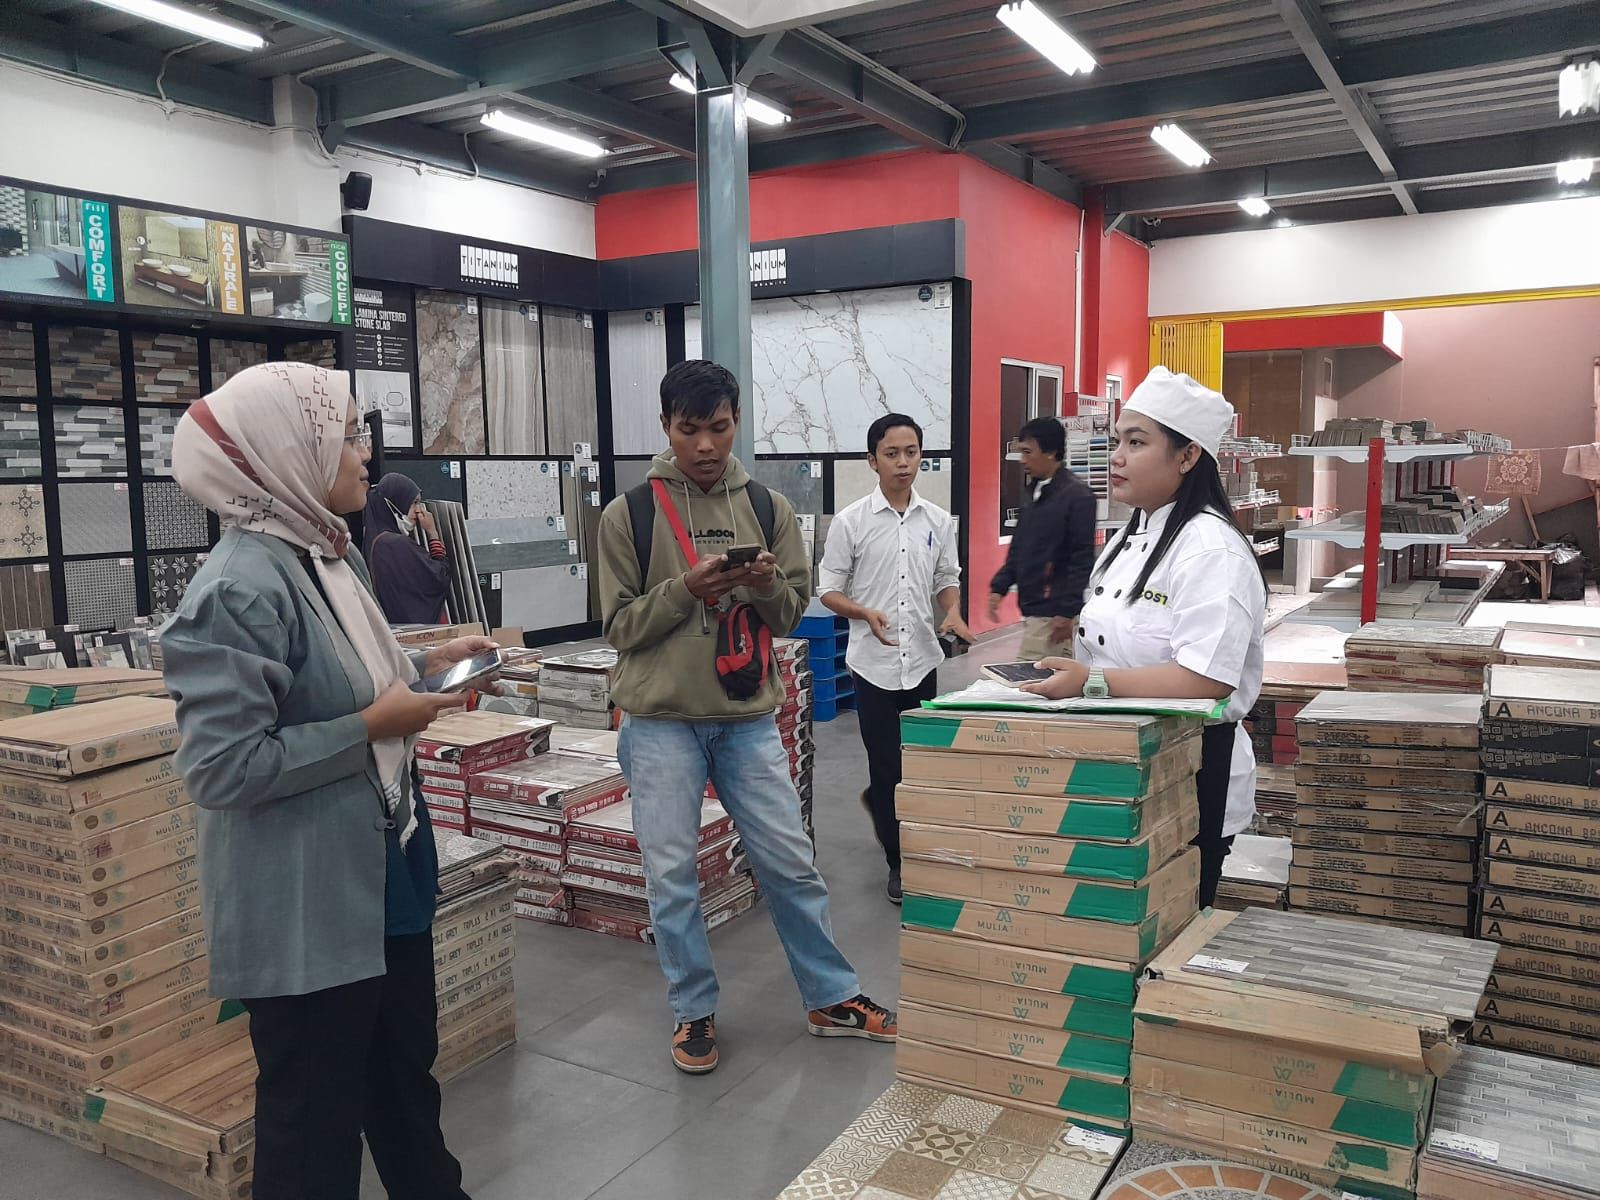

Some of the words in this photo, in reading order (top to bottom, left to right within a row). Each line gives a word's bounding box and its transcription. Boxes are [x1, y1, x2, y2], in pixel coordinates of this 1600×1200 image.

[88, 214, 107, 298] COMFORT
[462, 255, 518, 273] TITANIUM
[221, 232, 238, 311] NATURALE
[334, 250, 349, 322] CONCEPT
[354, 307, 378, 320] LAMINA
[355, 318, 375, 329] STONE
[375, 320, 391, 331] SLAB
[1496, 702, 1512, 717] A
[1526, 704, 1580, 719] ANCONA
[1492, 781, 1508, 797] A
[1493, 810, 1509, 826] A
[1495, 838, 1512, 854] A
[1490, 896, 1505, 911] A
[1487, 921, 1503, 937] A
[1484, 974, 1499, 990] A
[1484, 999, 1499, 1015] A
[1479, 1024, 1494, 1041] A
[1240, 1121, 1308, 1145] MULIATILE
